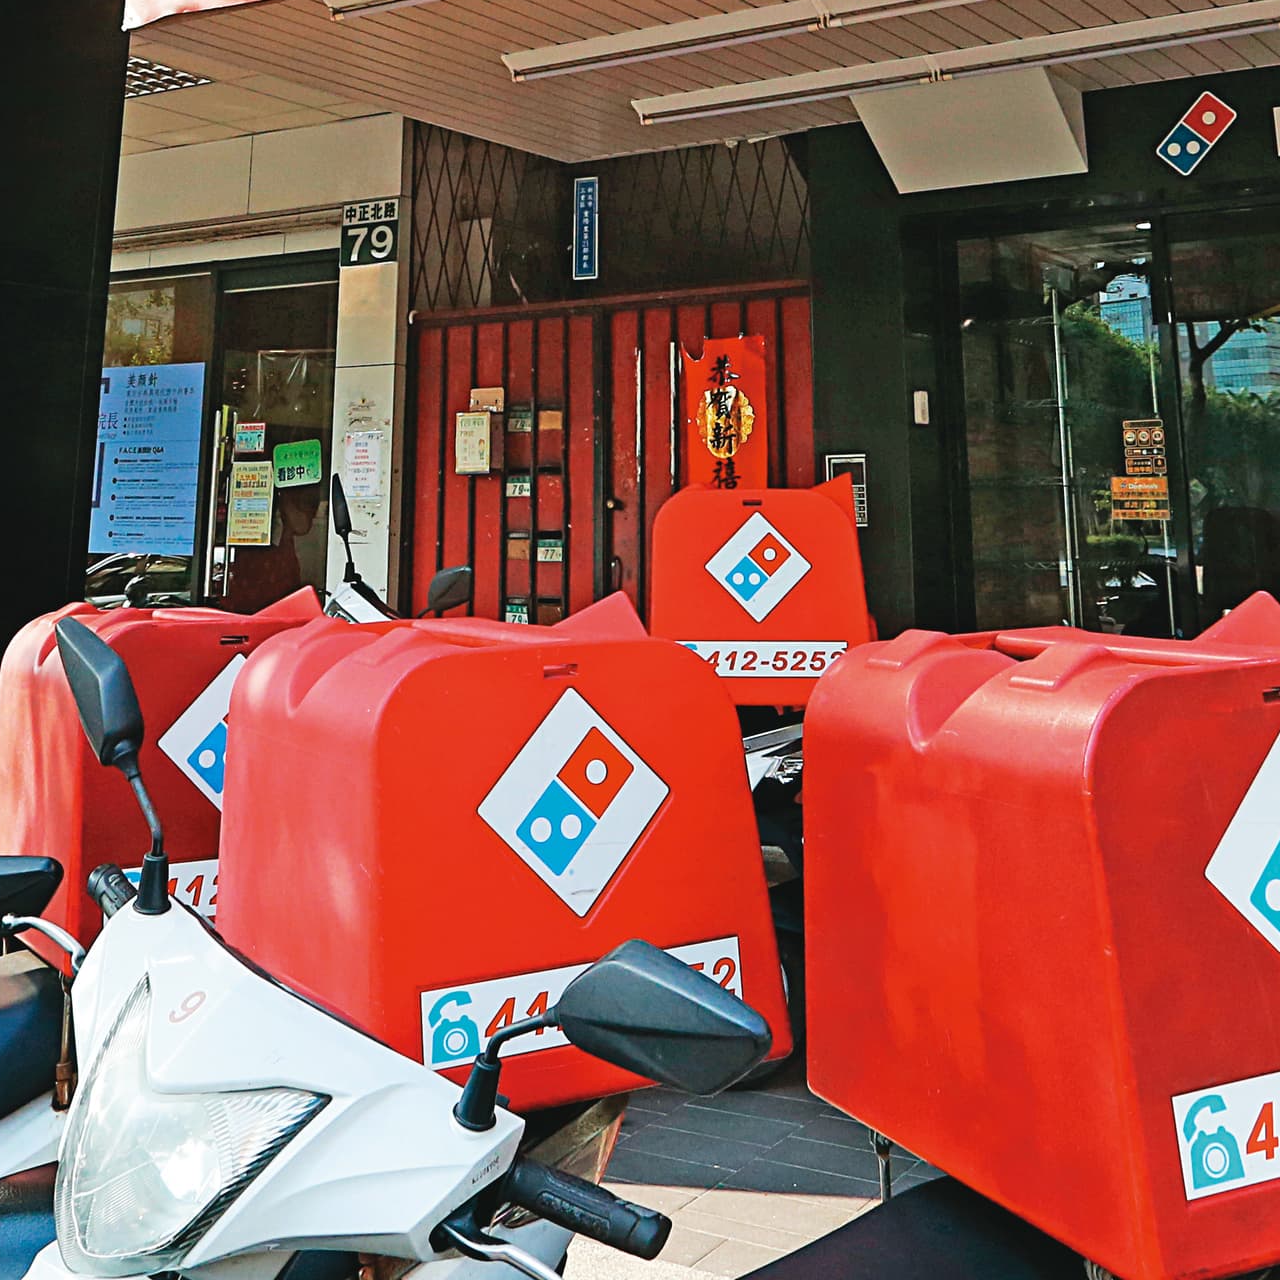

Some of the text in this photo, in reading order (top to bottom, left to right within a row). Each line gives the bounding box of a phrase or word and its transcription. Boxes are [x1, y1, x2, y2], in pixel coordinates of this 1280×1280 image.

[344, 199, 397, 222] 中正北路
[346, 225, 394, 263] 79
[707, 355, 742, 490] 恭賀新禧
